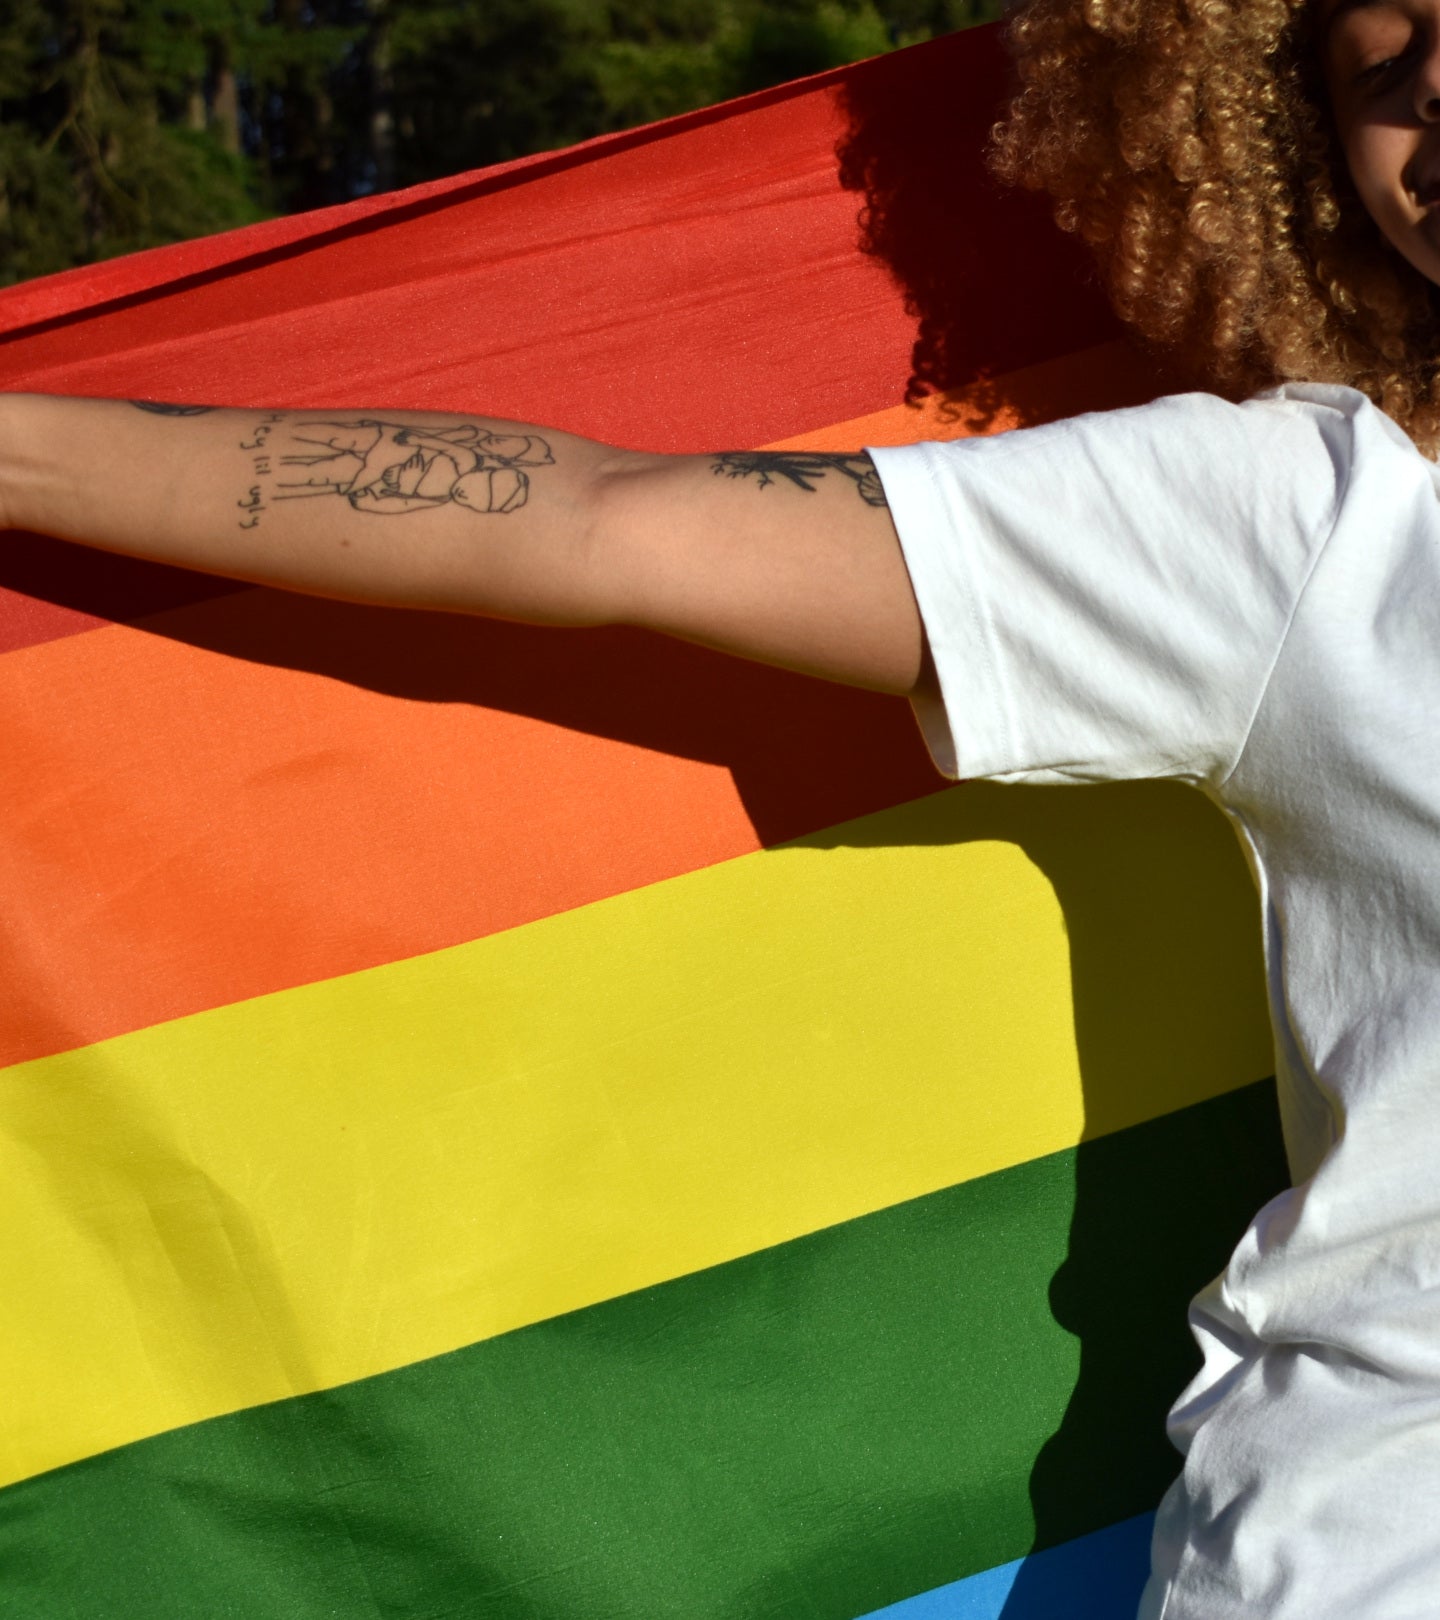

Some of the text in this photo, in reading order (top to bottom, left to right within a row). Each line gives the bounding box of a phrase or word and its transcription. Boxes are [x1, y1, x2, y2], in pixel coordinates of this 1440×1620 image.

[237, 413, 287, 529] Hey lil ugly
